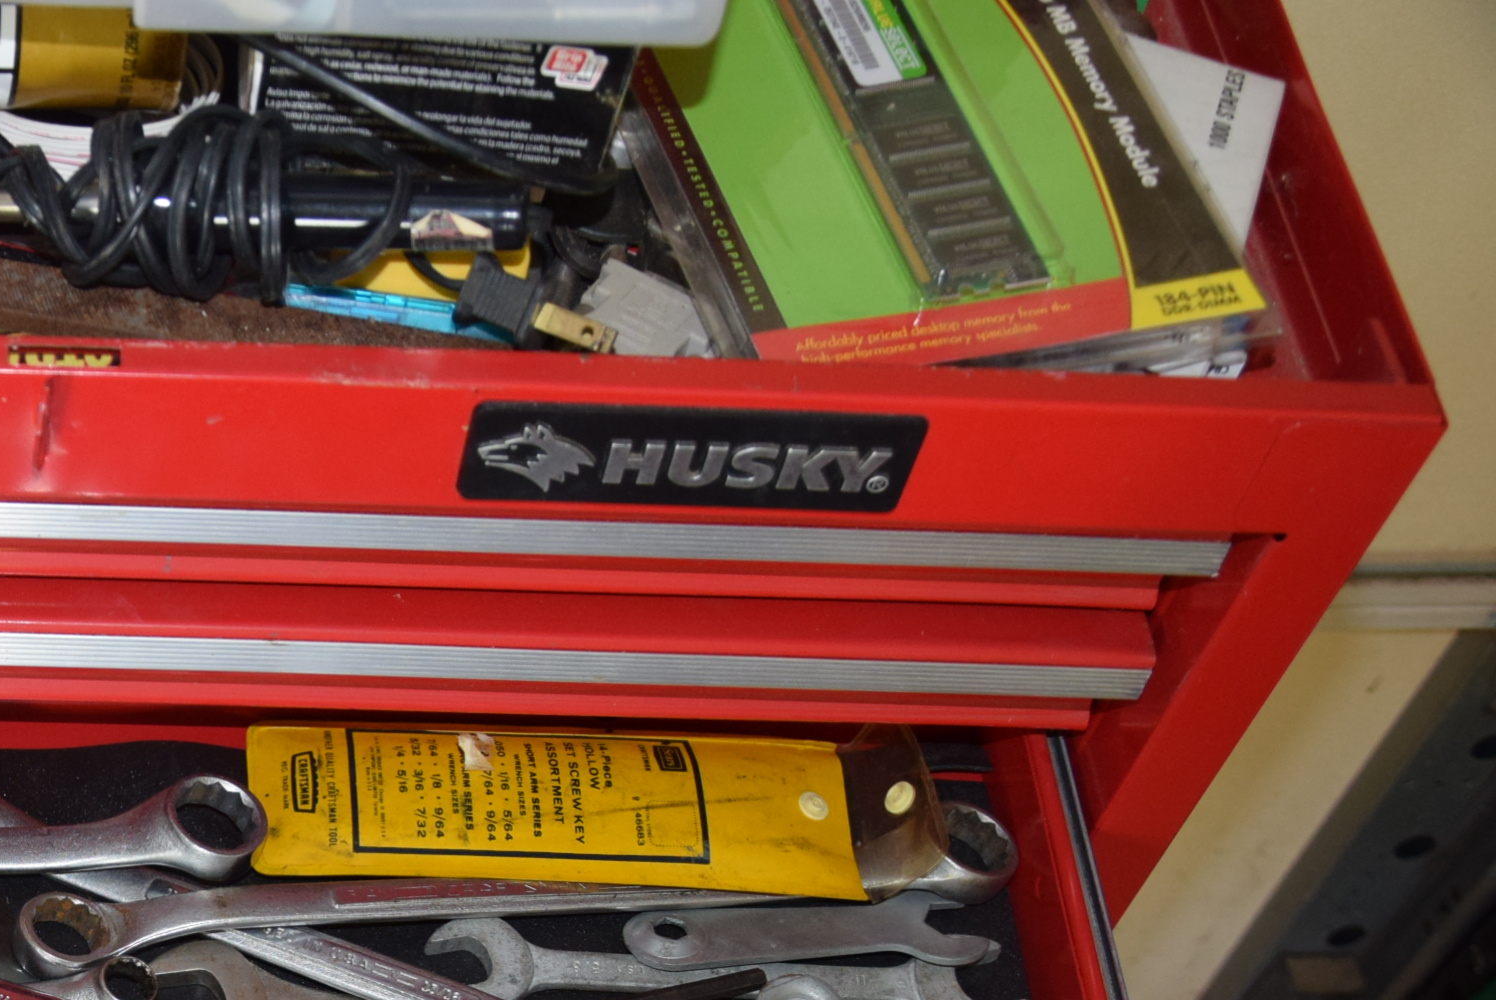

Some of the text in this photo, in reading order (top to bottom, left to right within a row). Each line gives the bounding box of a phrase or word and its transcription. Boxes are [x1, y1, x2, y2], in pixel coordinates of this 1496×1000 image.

[1046, 5, 1160, 188] MB Memory Module
[1216, 69, 1245, 121] STAPLES
[684, 157, 714, 209] TESTED
[712, 218, 764, 313] COMPATIBLE
[1154, 282, 1236, 306] 184-PIN
[796, 331, 864, 352] Affordably
[868, 326, 907, 345] priced
[911, 318, 961, 338] desktop
[963, 311, 1015, 329] memory
[1018, 305, 1048, 319] from
[920, 334, 971, 351] memory
[602, 438, 892, 492] HUSKY
[298, 758, 310, 806] CRAFTSMAN
[325, 752, 335, 780] QUALITY
[395, 769, 408, 793] 5/16
[412, 769, 425, 791] 3/16
[426, 738, 445, 838] 7/64 1/8 9/64
[448, 753, 460, 815] WRENCH SIZES
[513, 753, 526, 816] WRENCH SIZES
[544, 742, 565, 825] ASSORTMENT
[582, 742, 601, 790] HOLLOW
[327, 781, 338, 825] CRAFTSMAN
[463, 791, 474, 831] SERIES
[498, 771, 514, 841] 1/16 5/64
[524, 743, 542, 838] SHORT ARM SERIES
[563, 742, 585, 845] SET SCREW KEY
[328, 826, 338, 848] TOOL
[415, 806, 427, 838] 7/32
[486, 810, 497, 842] 9/64
[635, 812, 646, 847] 46683
